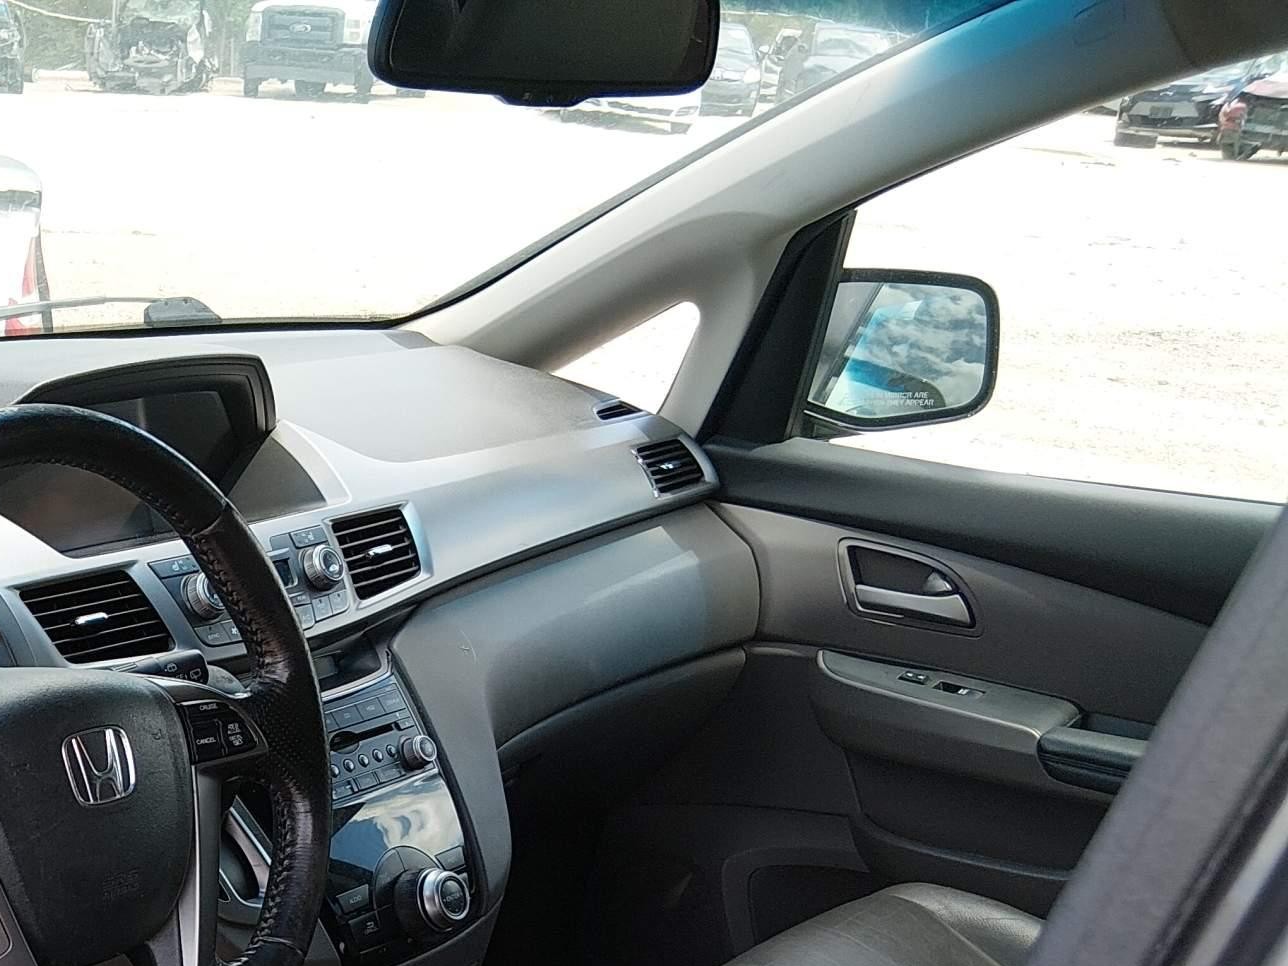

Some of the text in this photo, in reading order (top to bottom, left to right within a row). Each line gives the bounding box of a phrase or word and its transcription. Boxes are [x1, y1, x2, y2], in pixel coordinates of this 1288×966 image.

[913, 391, 929, 399] ARE
[905, 398, 935, 407] APPEAR
[195, 735, 218, 746] CANCEL
